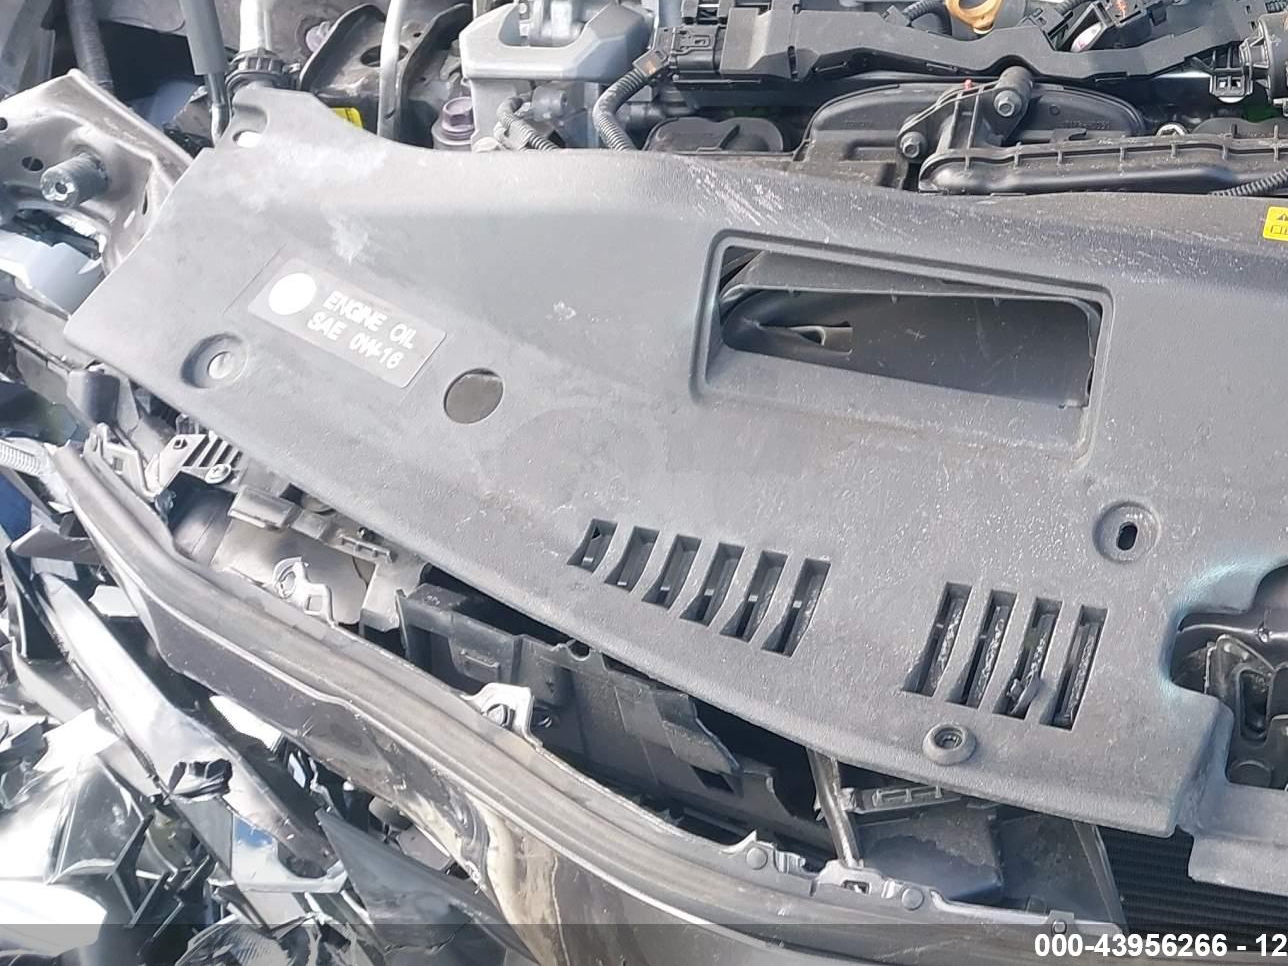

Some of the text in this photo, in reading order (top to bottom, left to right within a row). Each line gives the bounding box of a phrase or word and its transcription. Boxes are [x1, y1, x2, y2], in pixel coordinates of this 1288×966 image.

[307, 311, 347, 341] SAE
[322, 290, 417, 349] ENGINE OIL
